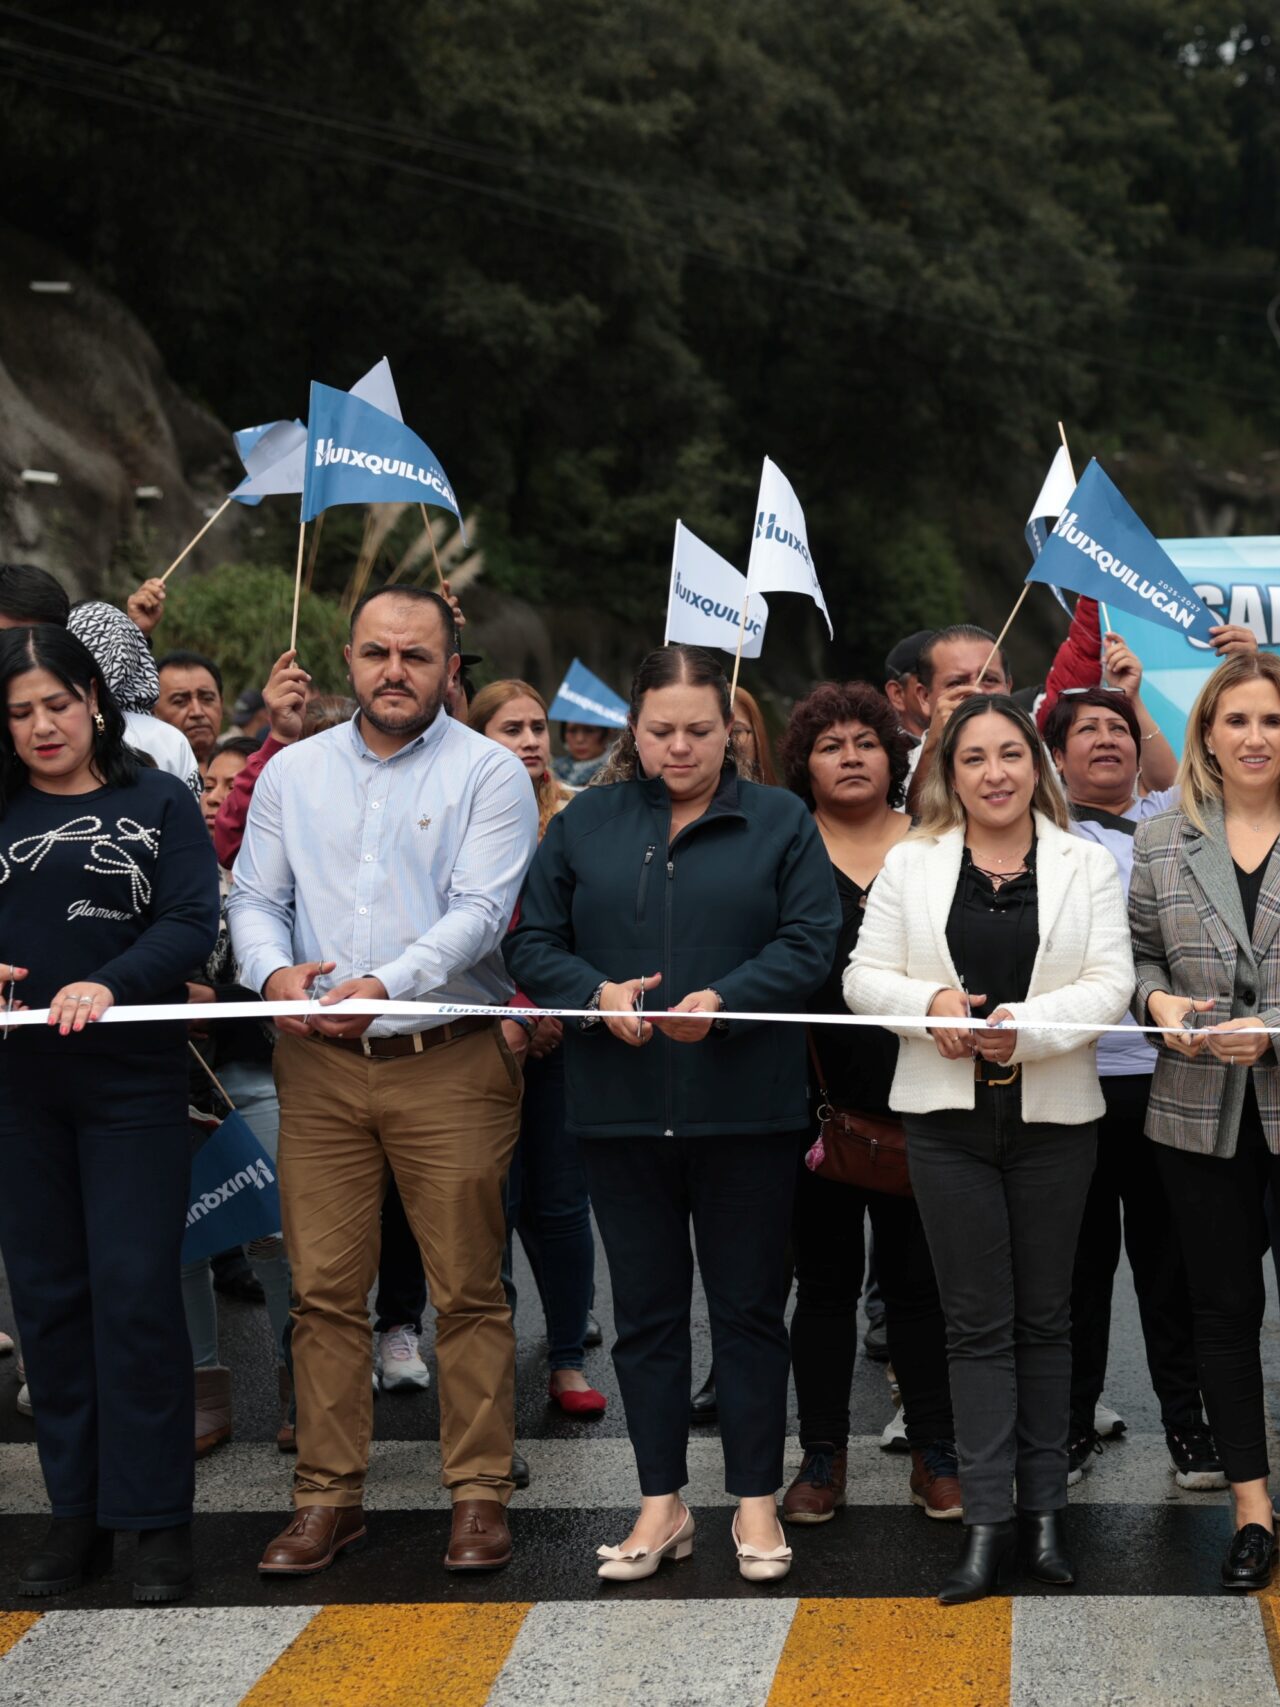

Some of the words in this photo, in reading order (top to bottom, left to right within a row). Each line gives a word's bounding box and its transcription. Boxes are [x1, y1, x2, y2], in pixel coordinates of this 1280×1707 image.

[1051, 508, 1196, 629] HUIXQUILUCAN
[1158, 579, 1201, 613] 2025-2027
[67, 899, 134, 921] Glamour
[184, 1157, 275, 1228] HUIXQUI
